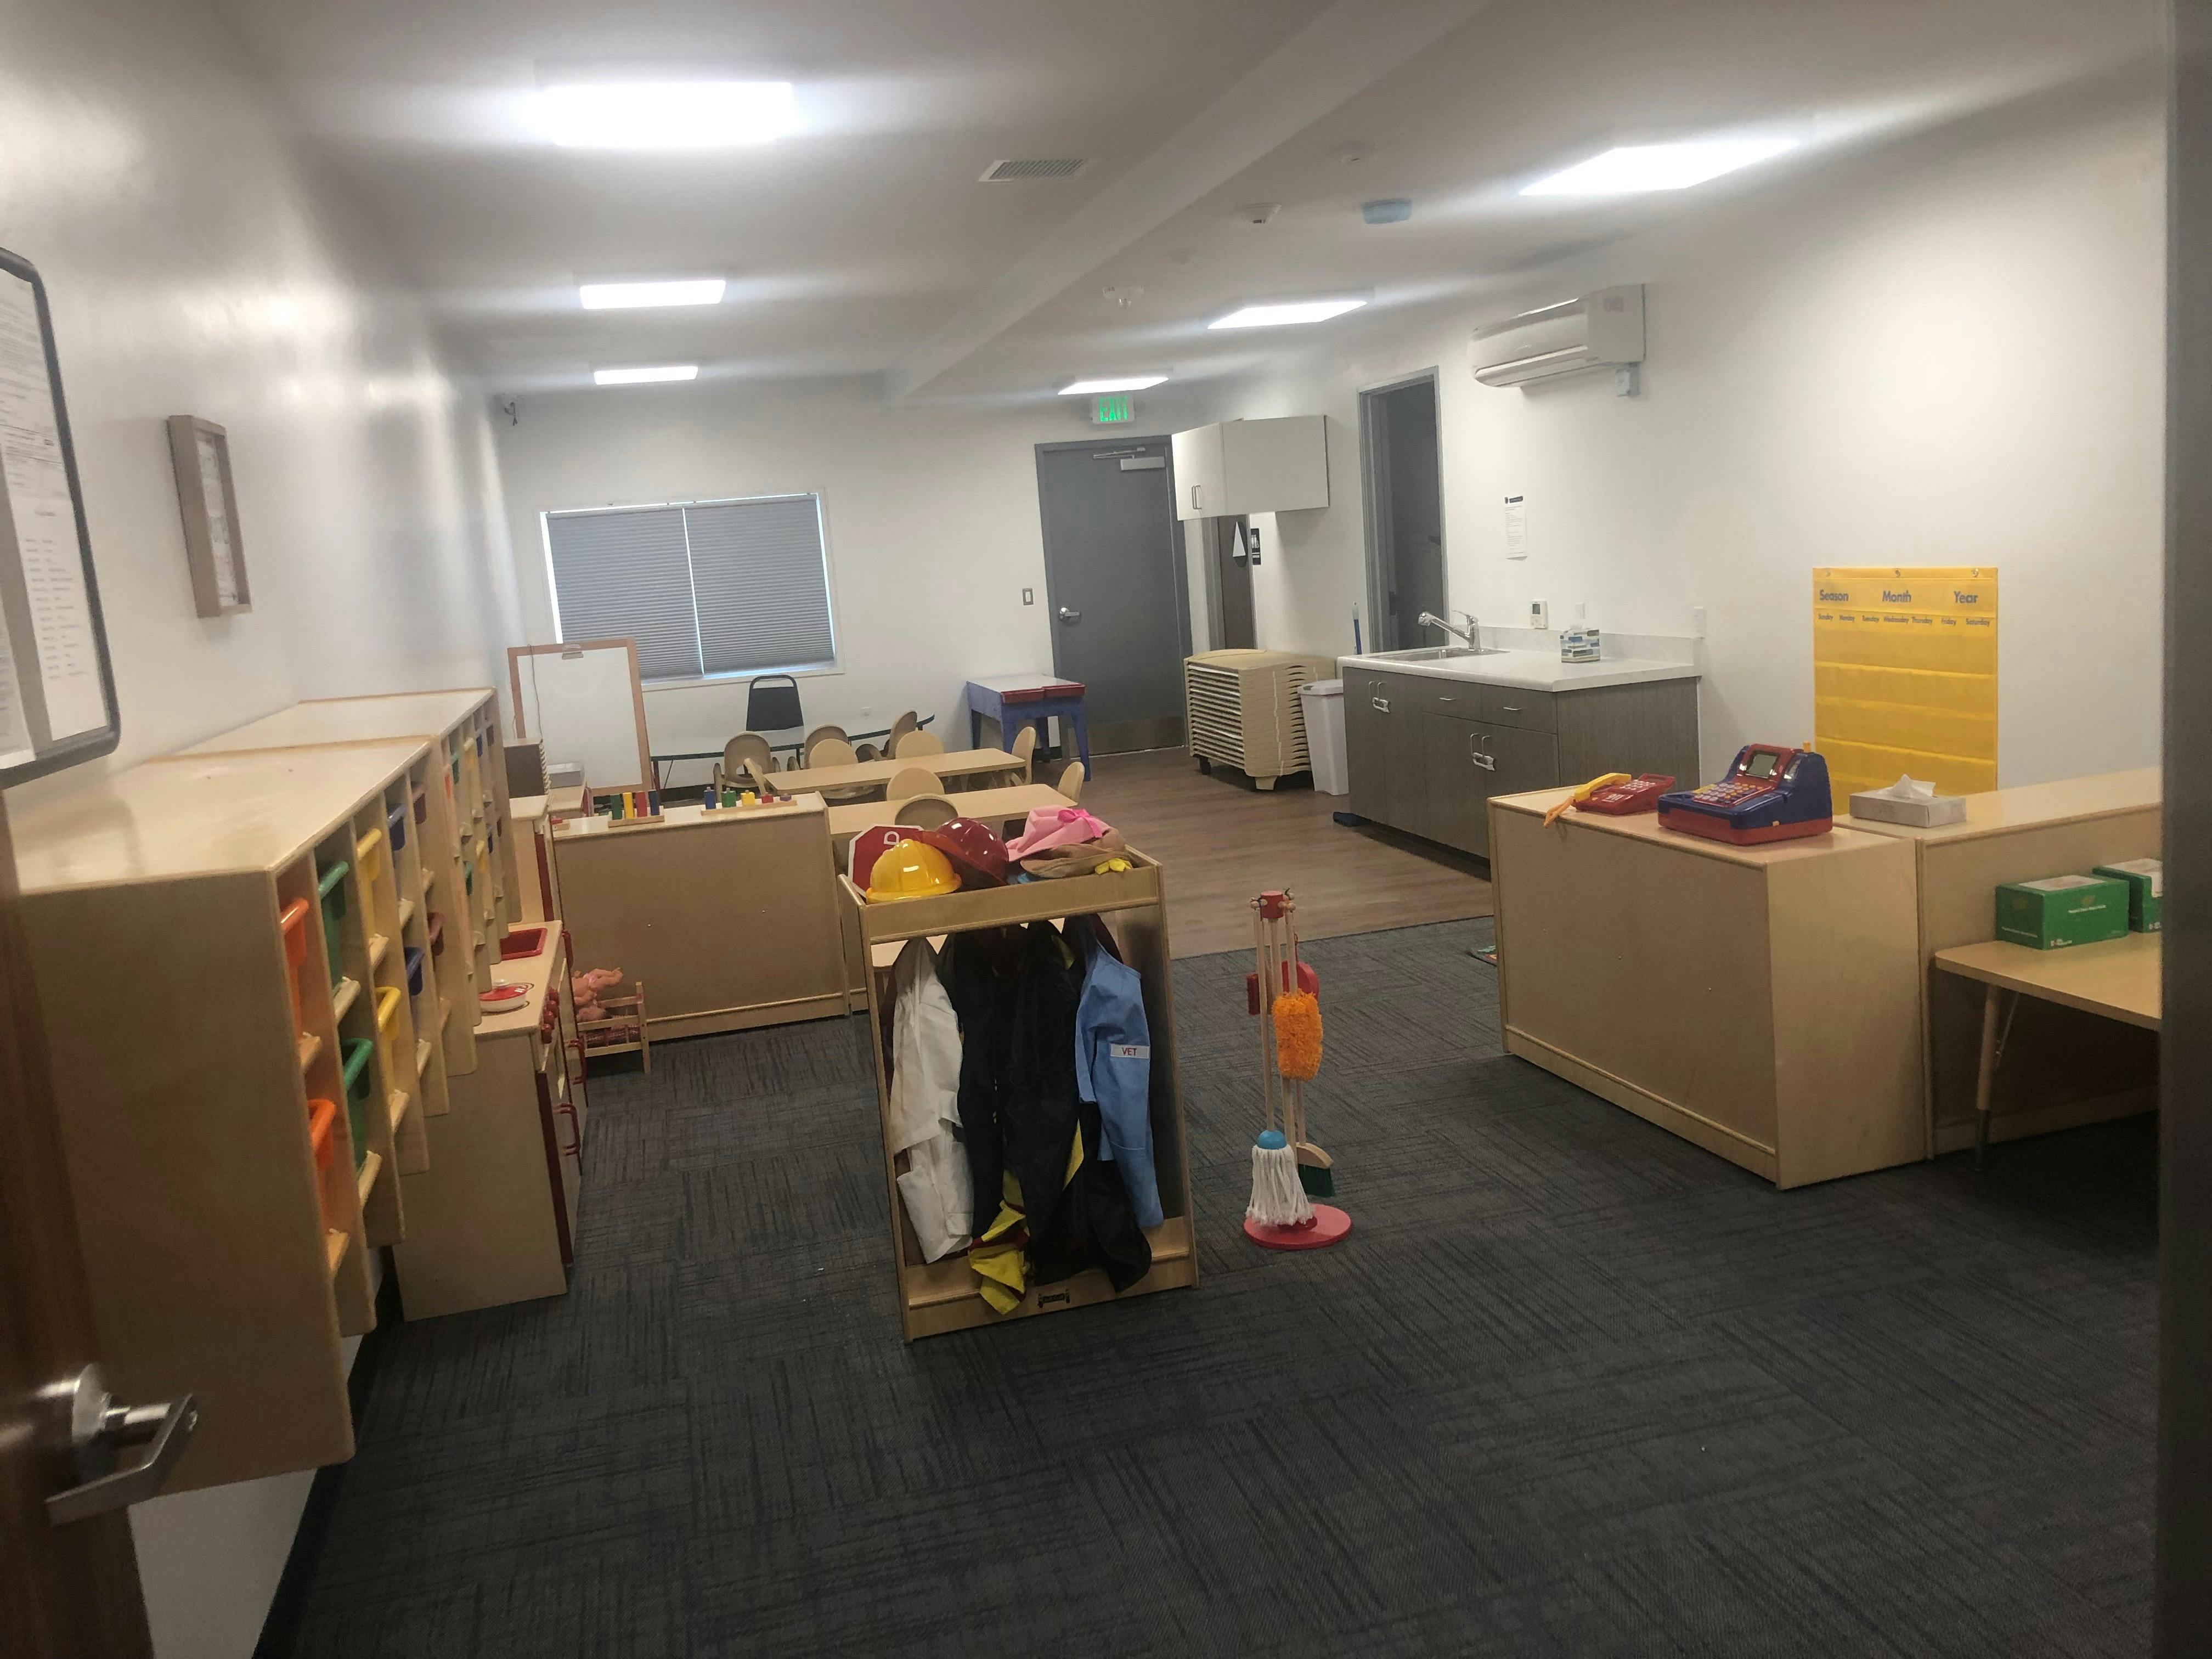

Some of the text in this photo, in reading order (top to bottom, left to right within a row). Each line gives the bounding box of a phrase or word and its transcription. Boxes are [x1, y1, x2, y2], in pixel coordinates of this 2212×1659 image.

[1099, 396, 1127, 421] EXIT
[1819, 589, 1978, 603] Season Month Year
[1818, 613, 1833, 622] Sunday
[1863, 615, 1879, 623] Tuesday
[1883, 616, 1909, 624] Wednesday
[1912, 616, 1933, 625] Thursday
[1941, 617, 1956, 627] Friday
[1966, 618, 1990, 627] Saturday
[1122, 1047, 1137, 1056] VET
